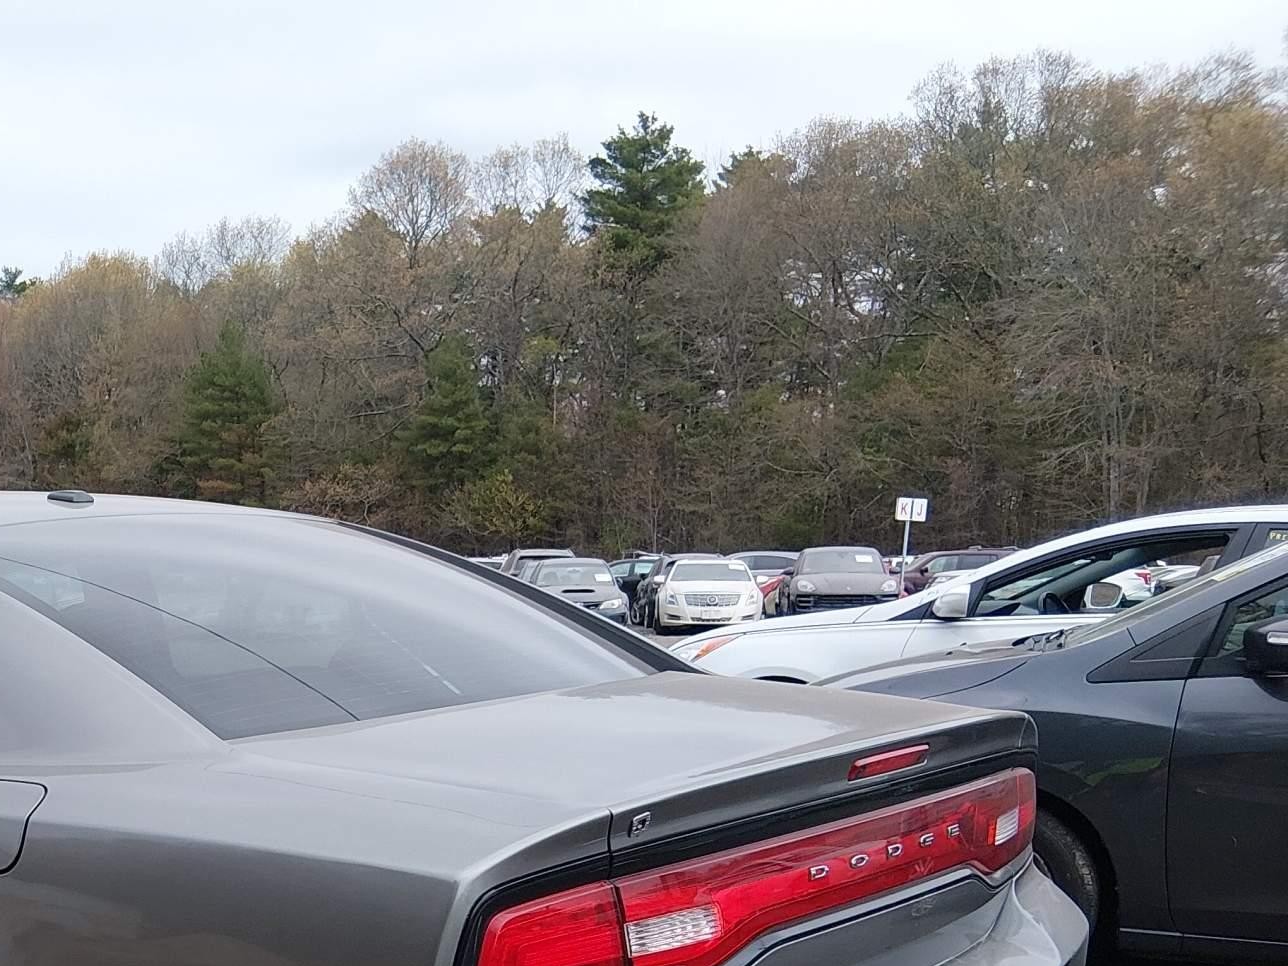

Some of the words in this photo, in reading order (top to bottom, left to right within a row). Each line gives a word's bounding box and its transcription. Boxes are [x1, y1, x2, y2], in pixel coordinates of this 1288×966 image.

[900, 502, 909, 516] K
[916, 503, 923, 517] J
[810, 823, 961, 880] DODGE
